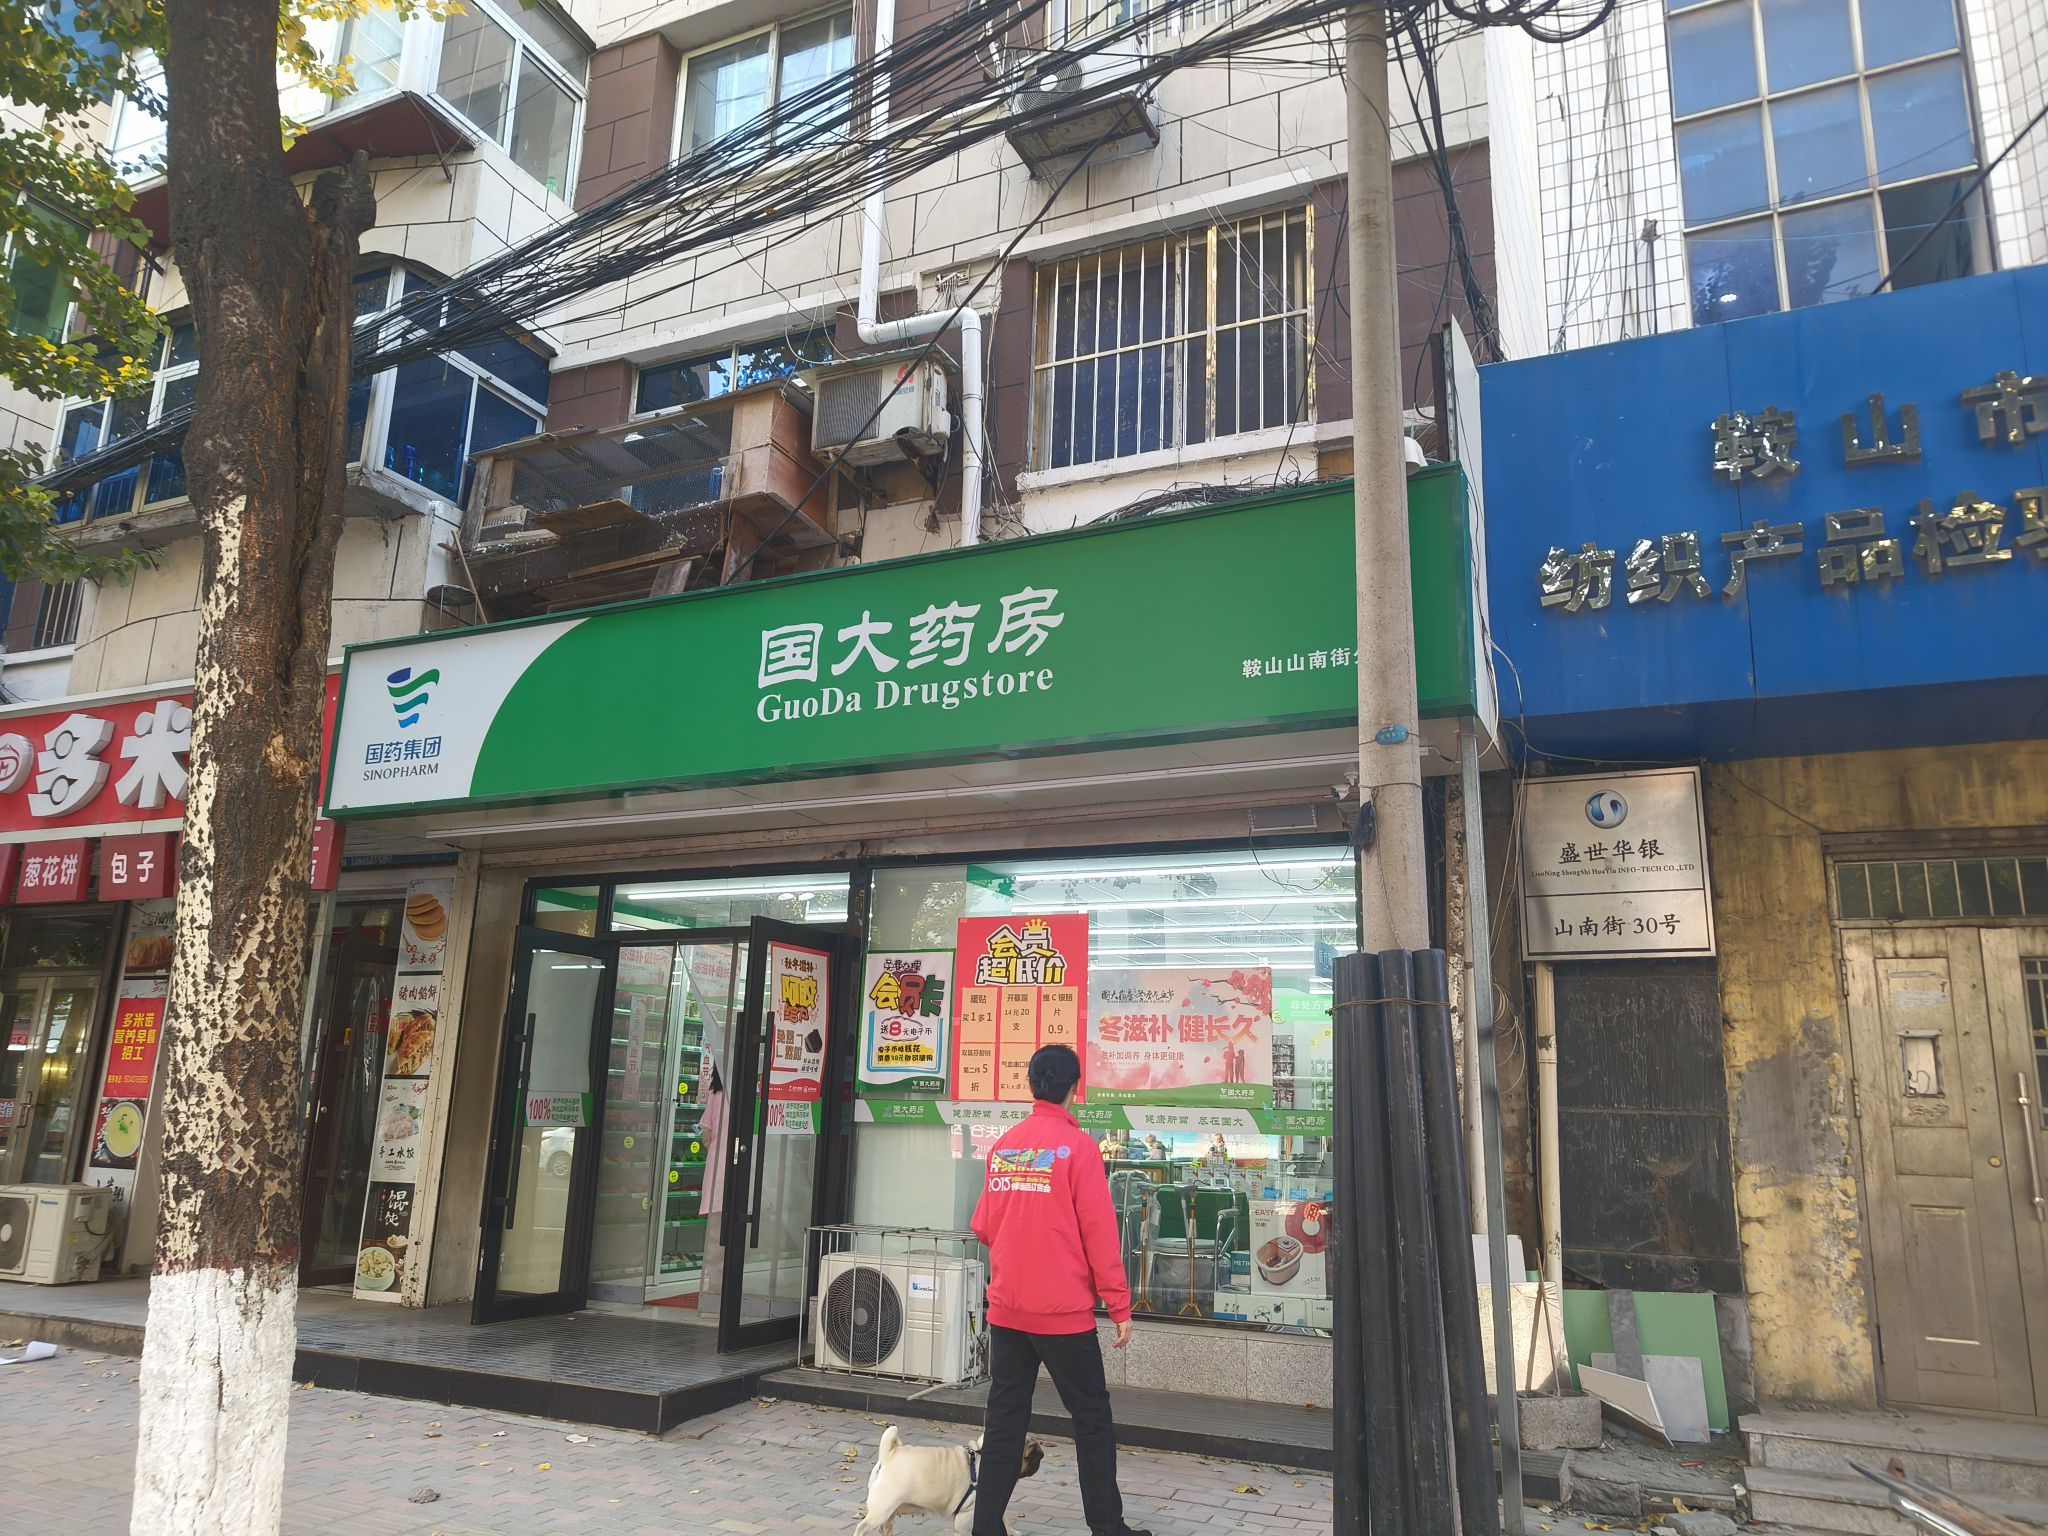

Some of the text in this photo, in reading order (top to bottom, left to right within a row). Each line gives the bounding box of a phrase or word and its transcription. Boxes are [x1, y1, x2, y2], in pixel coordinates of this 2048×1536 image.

[758, 586, 1064, 689] 国大药房
[1241, 647, 1358, 678] 鞍山山南街
[757, 667, 1054, 723] GuoDa Drugstore
[365, 736, 442, 765] 国药集团
[363, 763, 439, 781] SINOPHARM
[1558, 839, 1664, 864] 盛世华银
[23, 853, 79, 887] 葱花饼
[111, 851, 154, 884] 包子
[1554, 914, 1680, 937] 山南街30号
[987, 925, 1058, 957] 会员
[976, 956, 1066, 985] 超低价
[869, 972, 945, 1017] 会员卡
[1054, 1008, 1061, 1016] 片
[1048, 1025, 1063, 1034] 0.9
[1099, 1014, 1259, 1043] 冬滋补 健长久
[121, 1046, 145, 1060] 招工
[971, 1082, 979, 1092] 折
[530, 1098, 551, 1120] 100%
[1078, 1110, 1113, 1118] 国大药房
[1145, 1115, 1243, 1127] 健康所需 尽在国大
[1286, 1116, 1326, 1126] 国大药房
